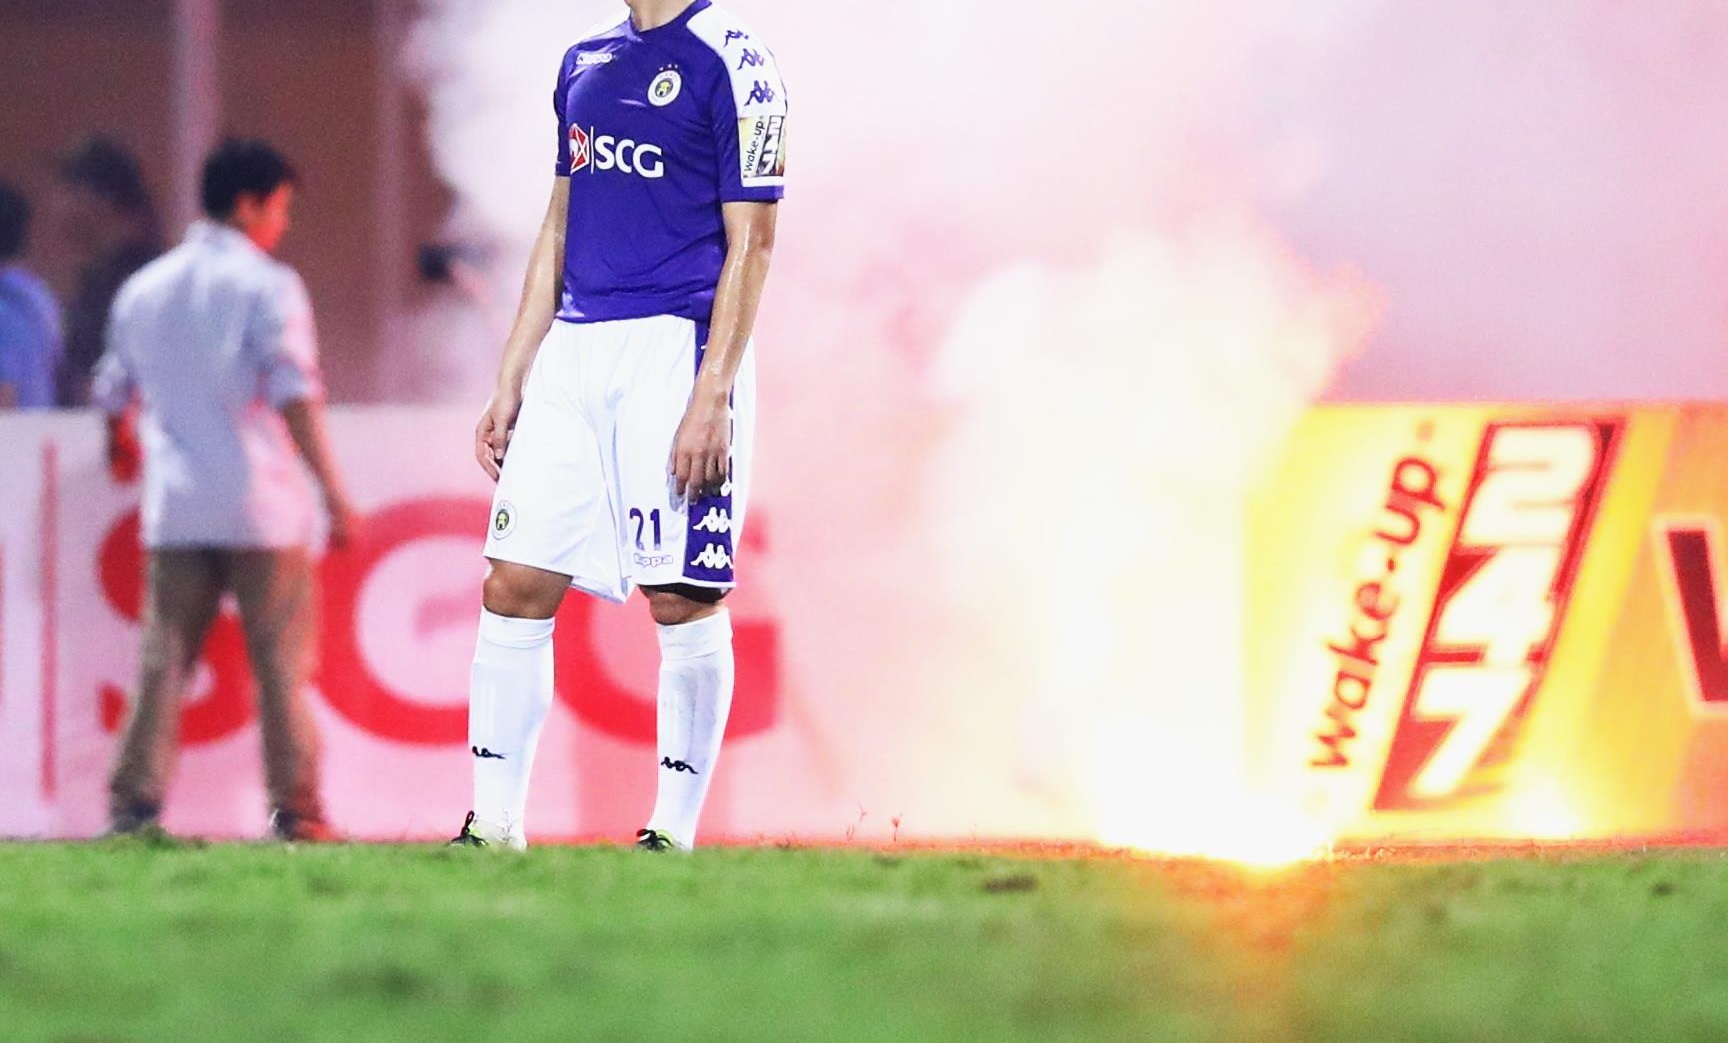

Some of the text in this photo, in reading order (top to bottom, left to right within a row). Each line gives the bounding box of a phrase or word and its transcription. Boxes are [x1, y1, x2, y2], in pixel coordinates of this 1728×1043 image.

[595, 135, 664, 178] SCG
[744, 120, 765, 172] wake-up
[629, 507, 661, 551] 21
[1311, 457, 1446, 768] wake-up
[1406, 423, 1598, 801] 247
